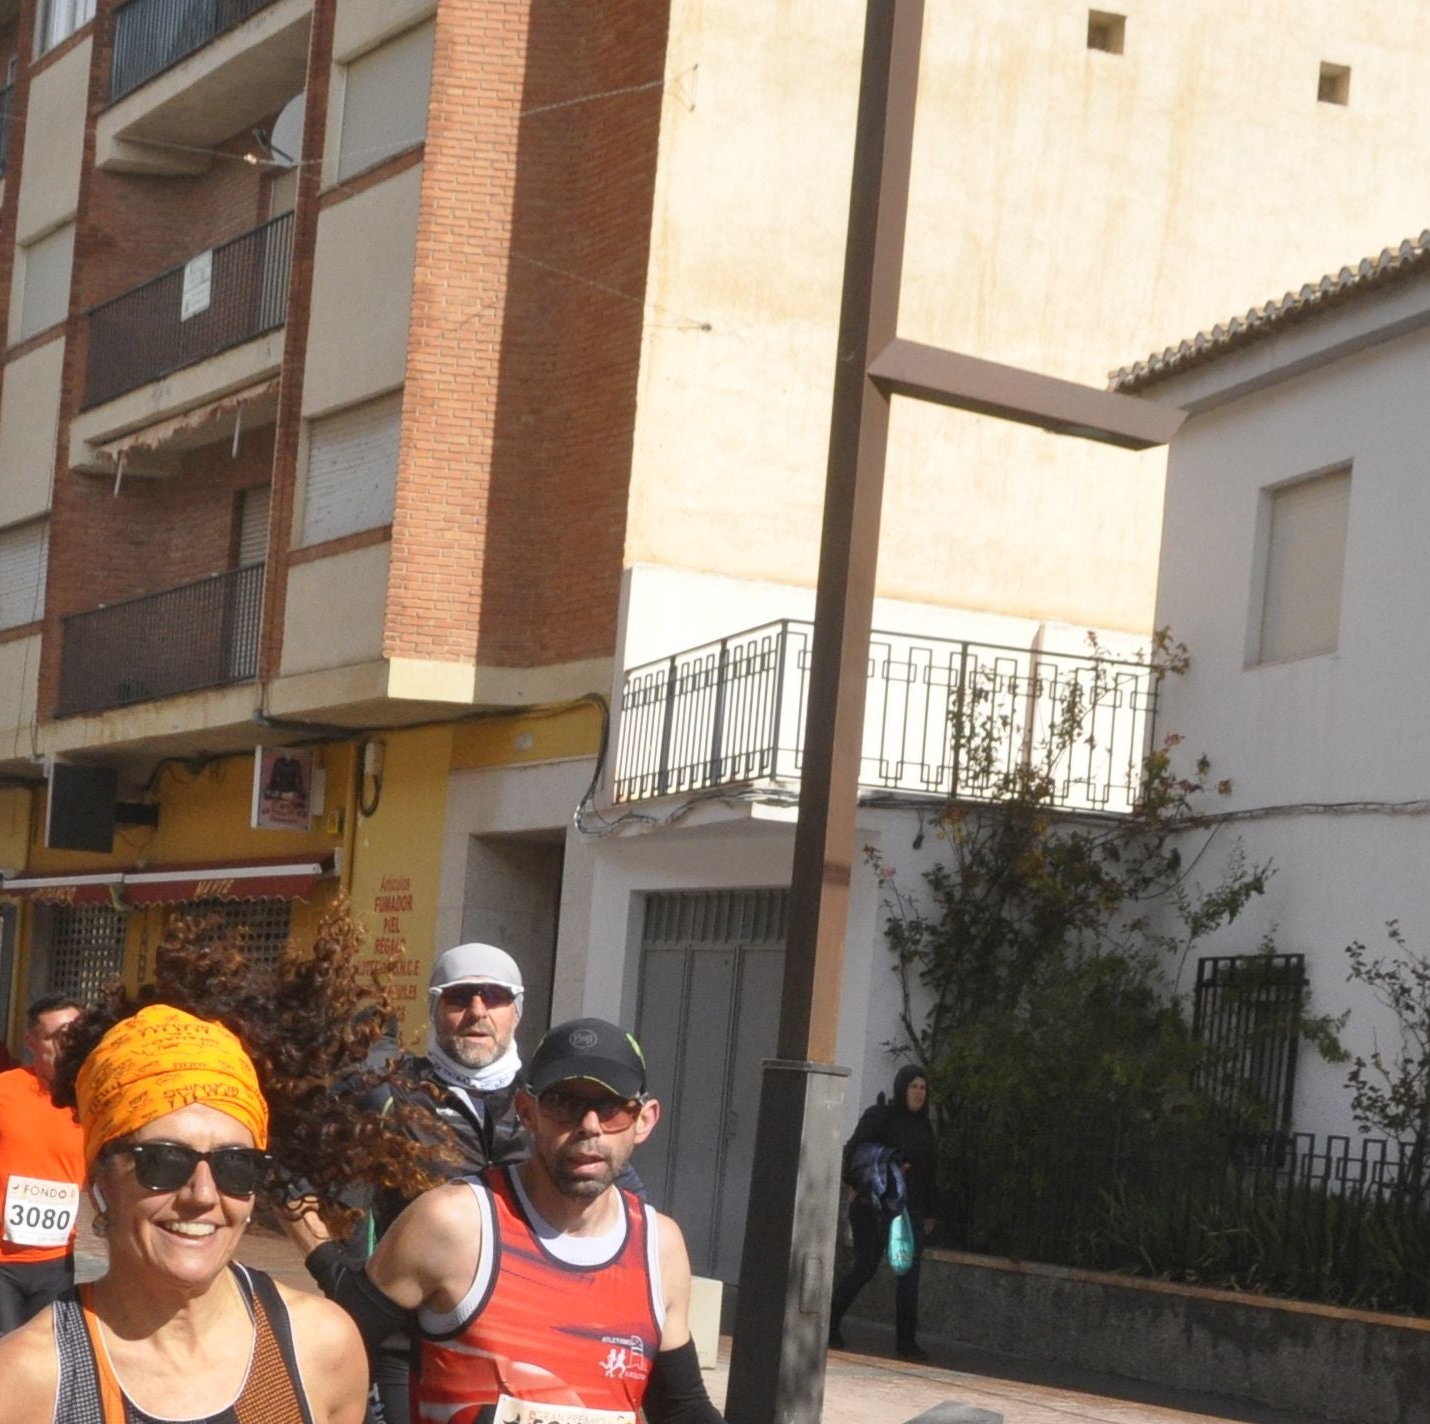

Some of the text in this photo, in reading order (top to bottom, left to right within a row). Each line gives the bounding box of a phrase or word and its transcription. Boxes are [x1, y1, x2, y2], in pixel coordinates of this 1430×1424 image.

[374, 895, 414, 912] FUMADOR
[24, 1184, 67, 1199] FONDO
[9, 1204, 71, 1230] 3080
